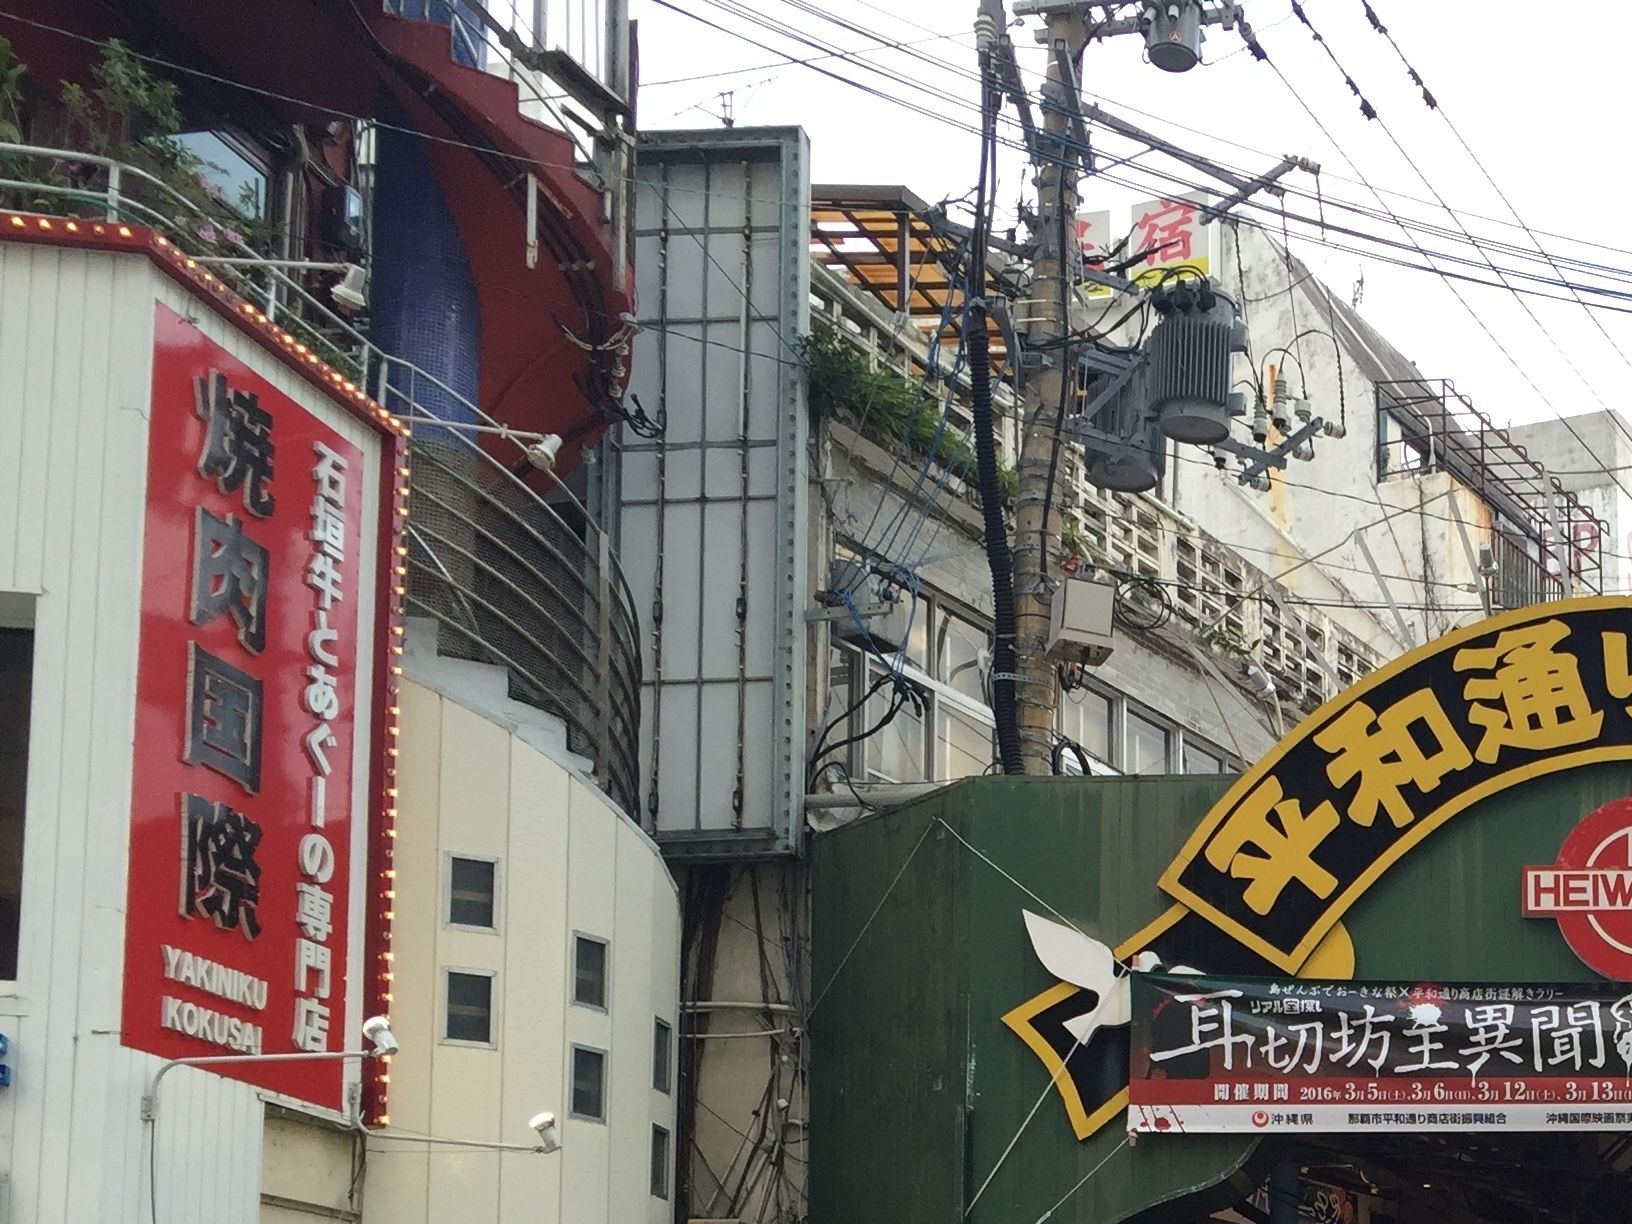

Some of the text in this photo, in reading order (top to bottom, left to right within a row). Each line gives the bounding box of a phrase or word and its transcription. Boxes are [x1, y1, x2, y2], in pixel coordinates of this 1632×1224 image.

[179, 367, 276, 943] 焼肉国際
[291, 441, 349, 1053] 石垣牛とあぐーの専門店
[162, 945, 268, 1012] YAKINIKU
[160, 995, 264, 1057] KOKUSAI
[1213, 1083, 1289, 1101] 開催期間
[1271, 1112, 1313, 1126] 沖縄県
